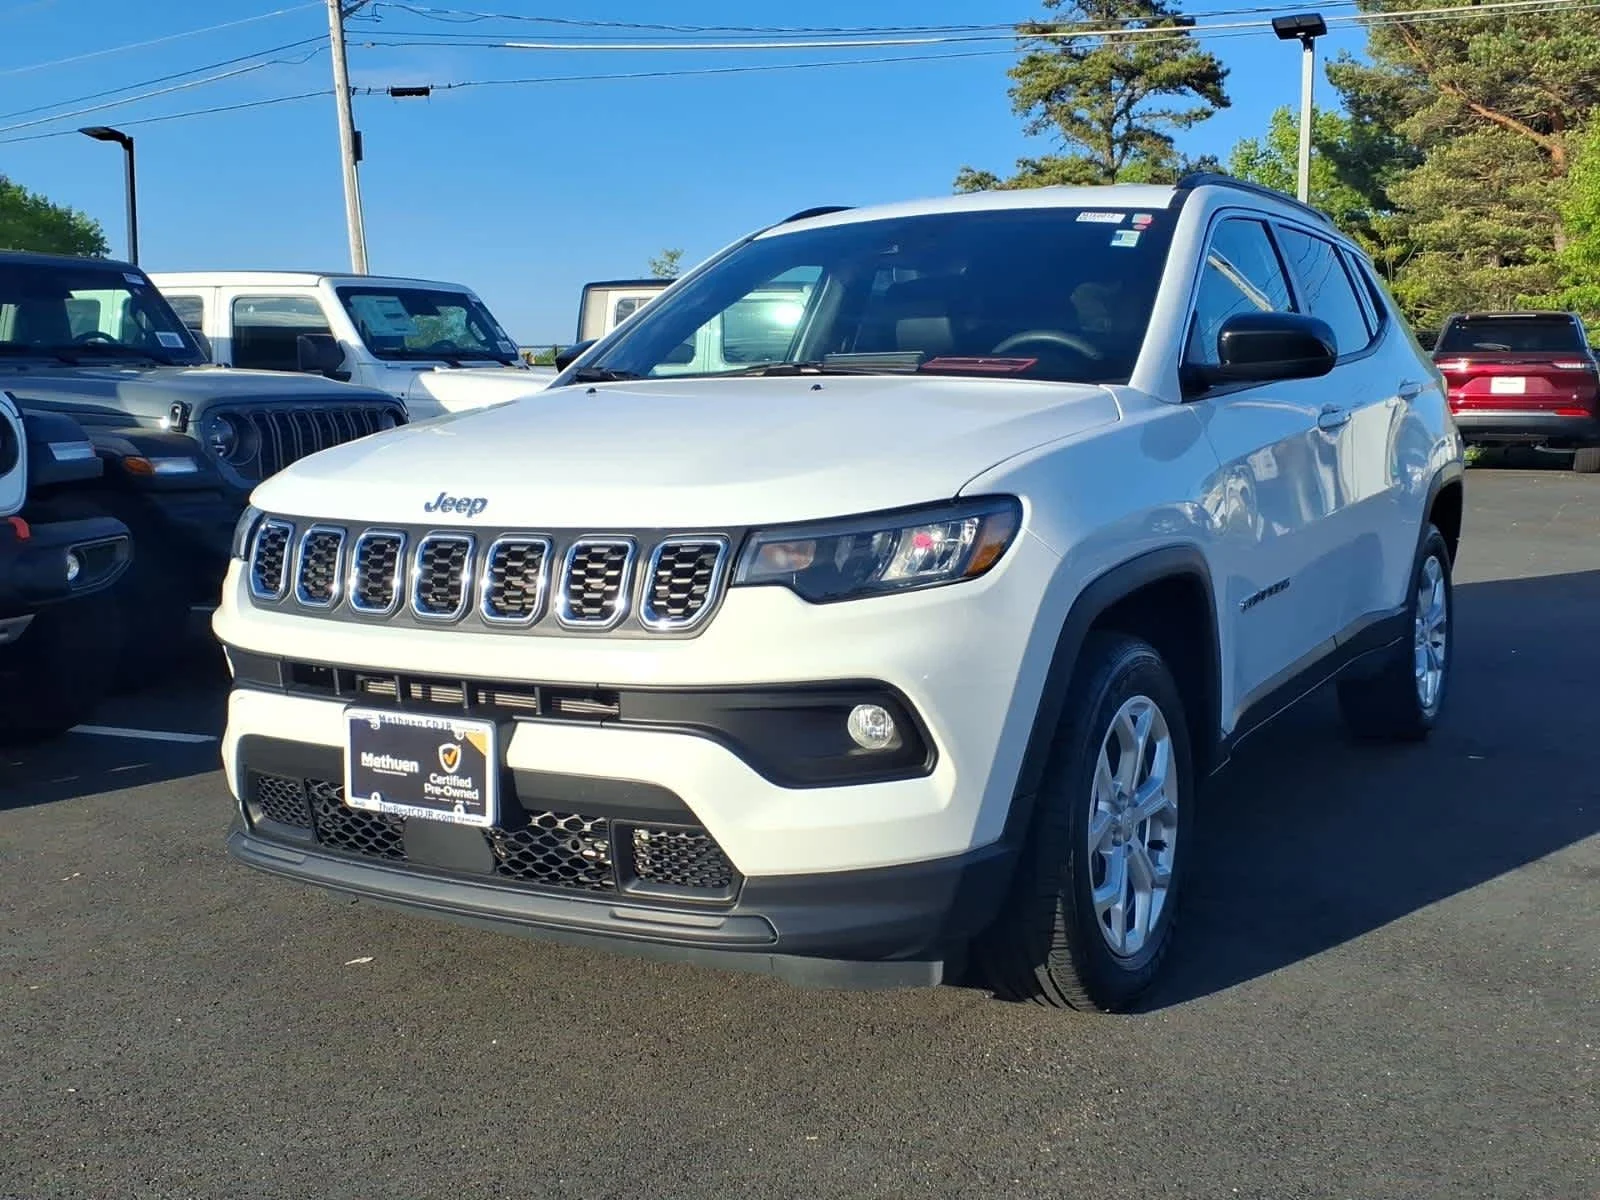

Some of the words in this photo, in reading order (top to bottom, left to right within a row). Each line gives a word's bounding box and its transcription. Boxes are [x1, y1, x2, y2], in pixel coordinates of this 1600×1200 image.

[424, 491, 488, 518] Jeep
[378, 713, 423, 727] Methuen
[361, 752, 419, 773] Methuen
[429, 772, 472, 789] Certified
[423, 782, 480, 800] Pre-Owned
[379, 802, 455, 824] TheBestCDJR.com
